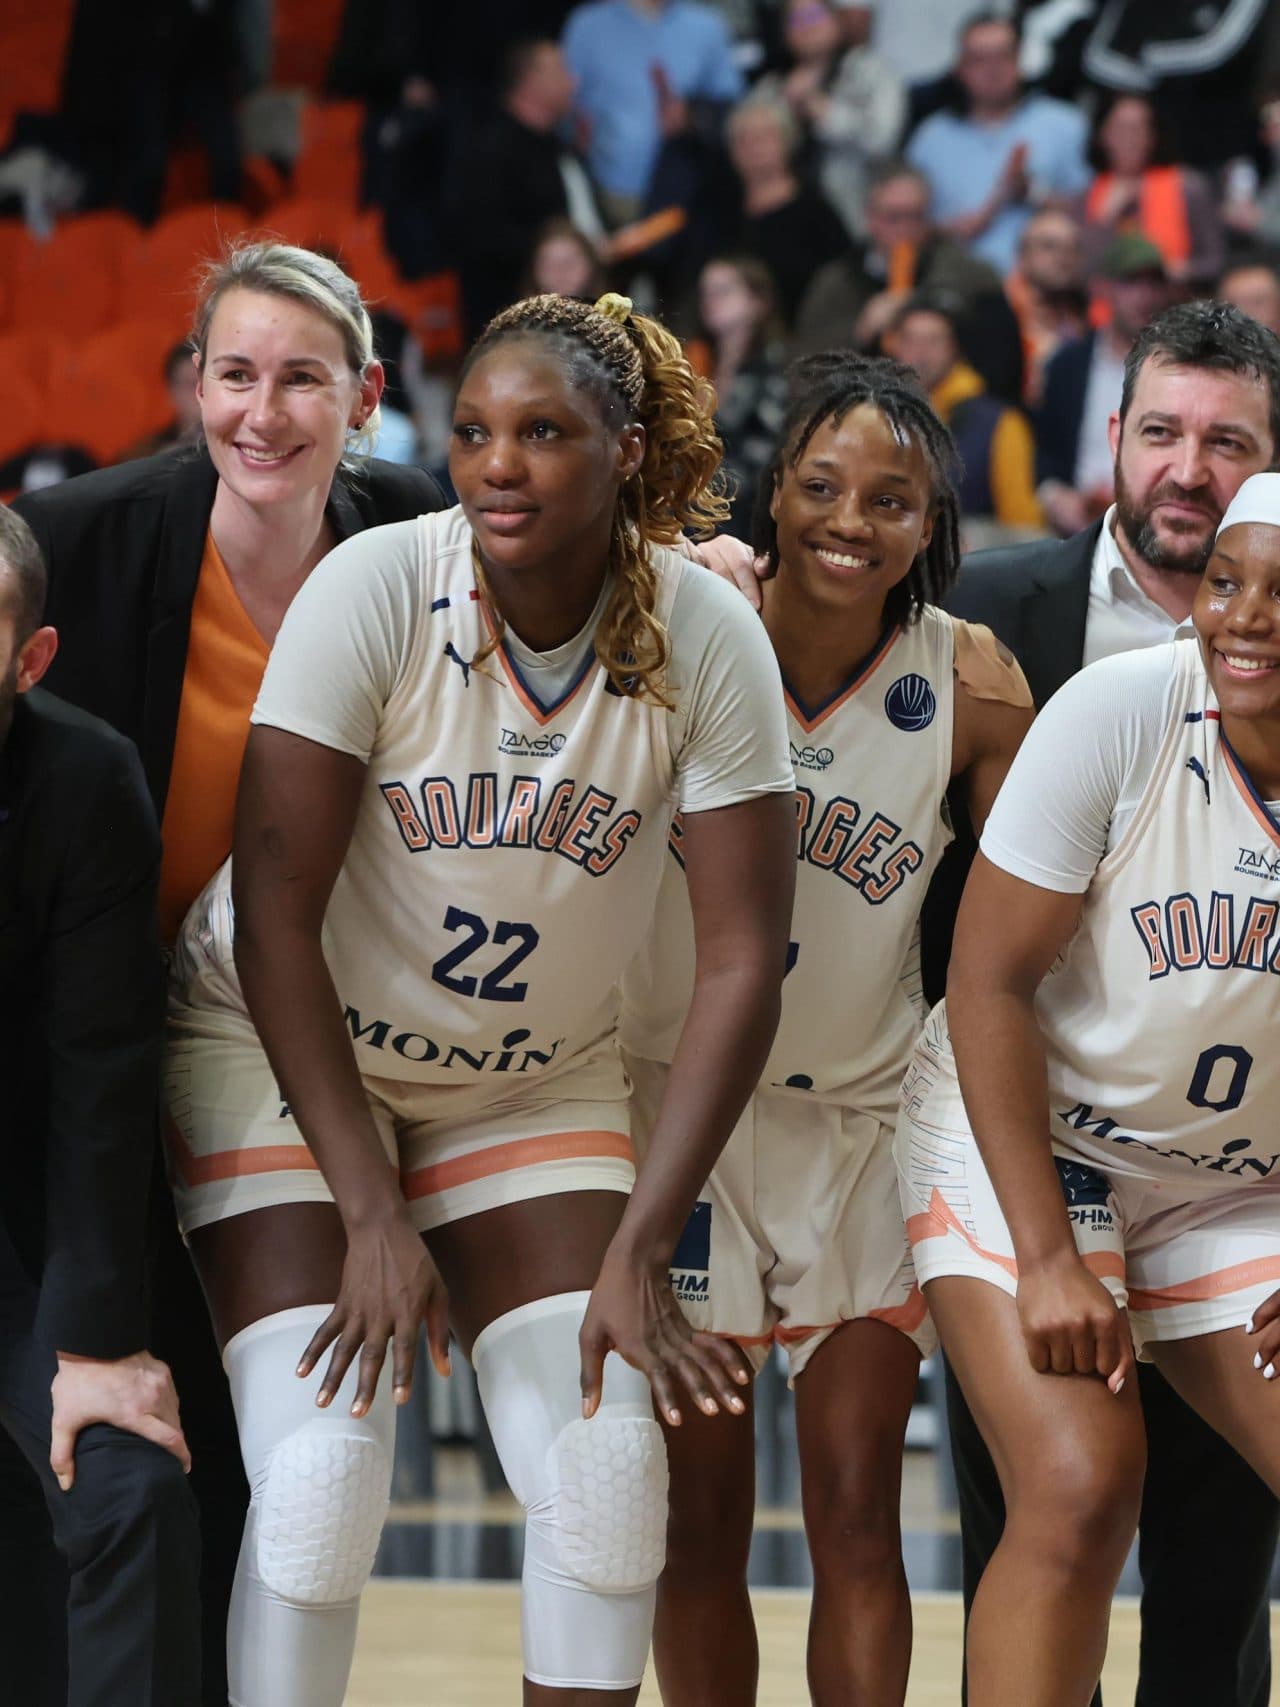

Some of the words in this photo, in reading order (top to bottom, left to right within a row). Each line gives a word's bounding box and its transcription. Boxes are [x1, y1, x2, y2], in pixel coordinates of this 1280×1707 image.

[501, 728, 567, 752] TANGO
[790, 741, 834, 765] NGO
[379, 773, 641, 877] BOURGES
[432, 905, 540, 1002] 22
[345, 1005, 561, 1072] MONIN
[1186, 1044, 1253, 1112] 0
[668, 1273, 709, 1292] HM
[677, 1293, 710, 1302] GROUP
